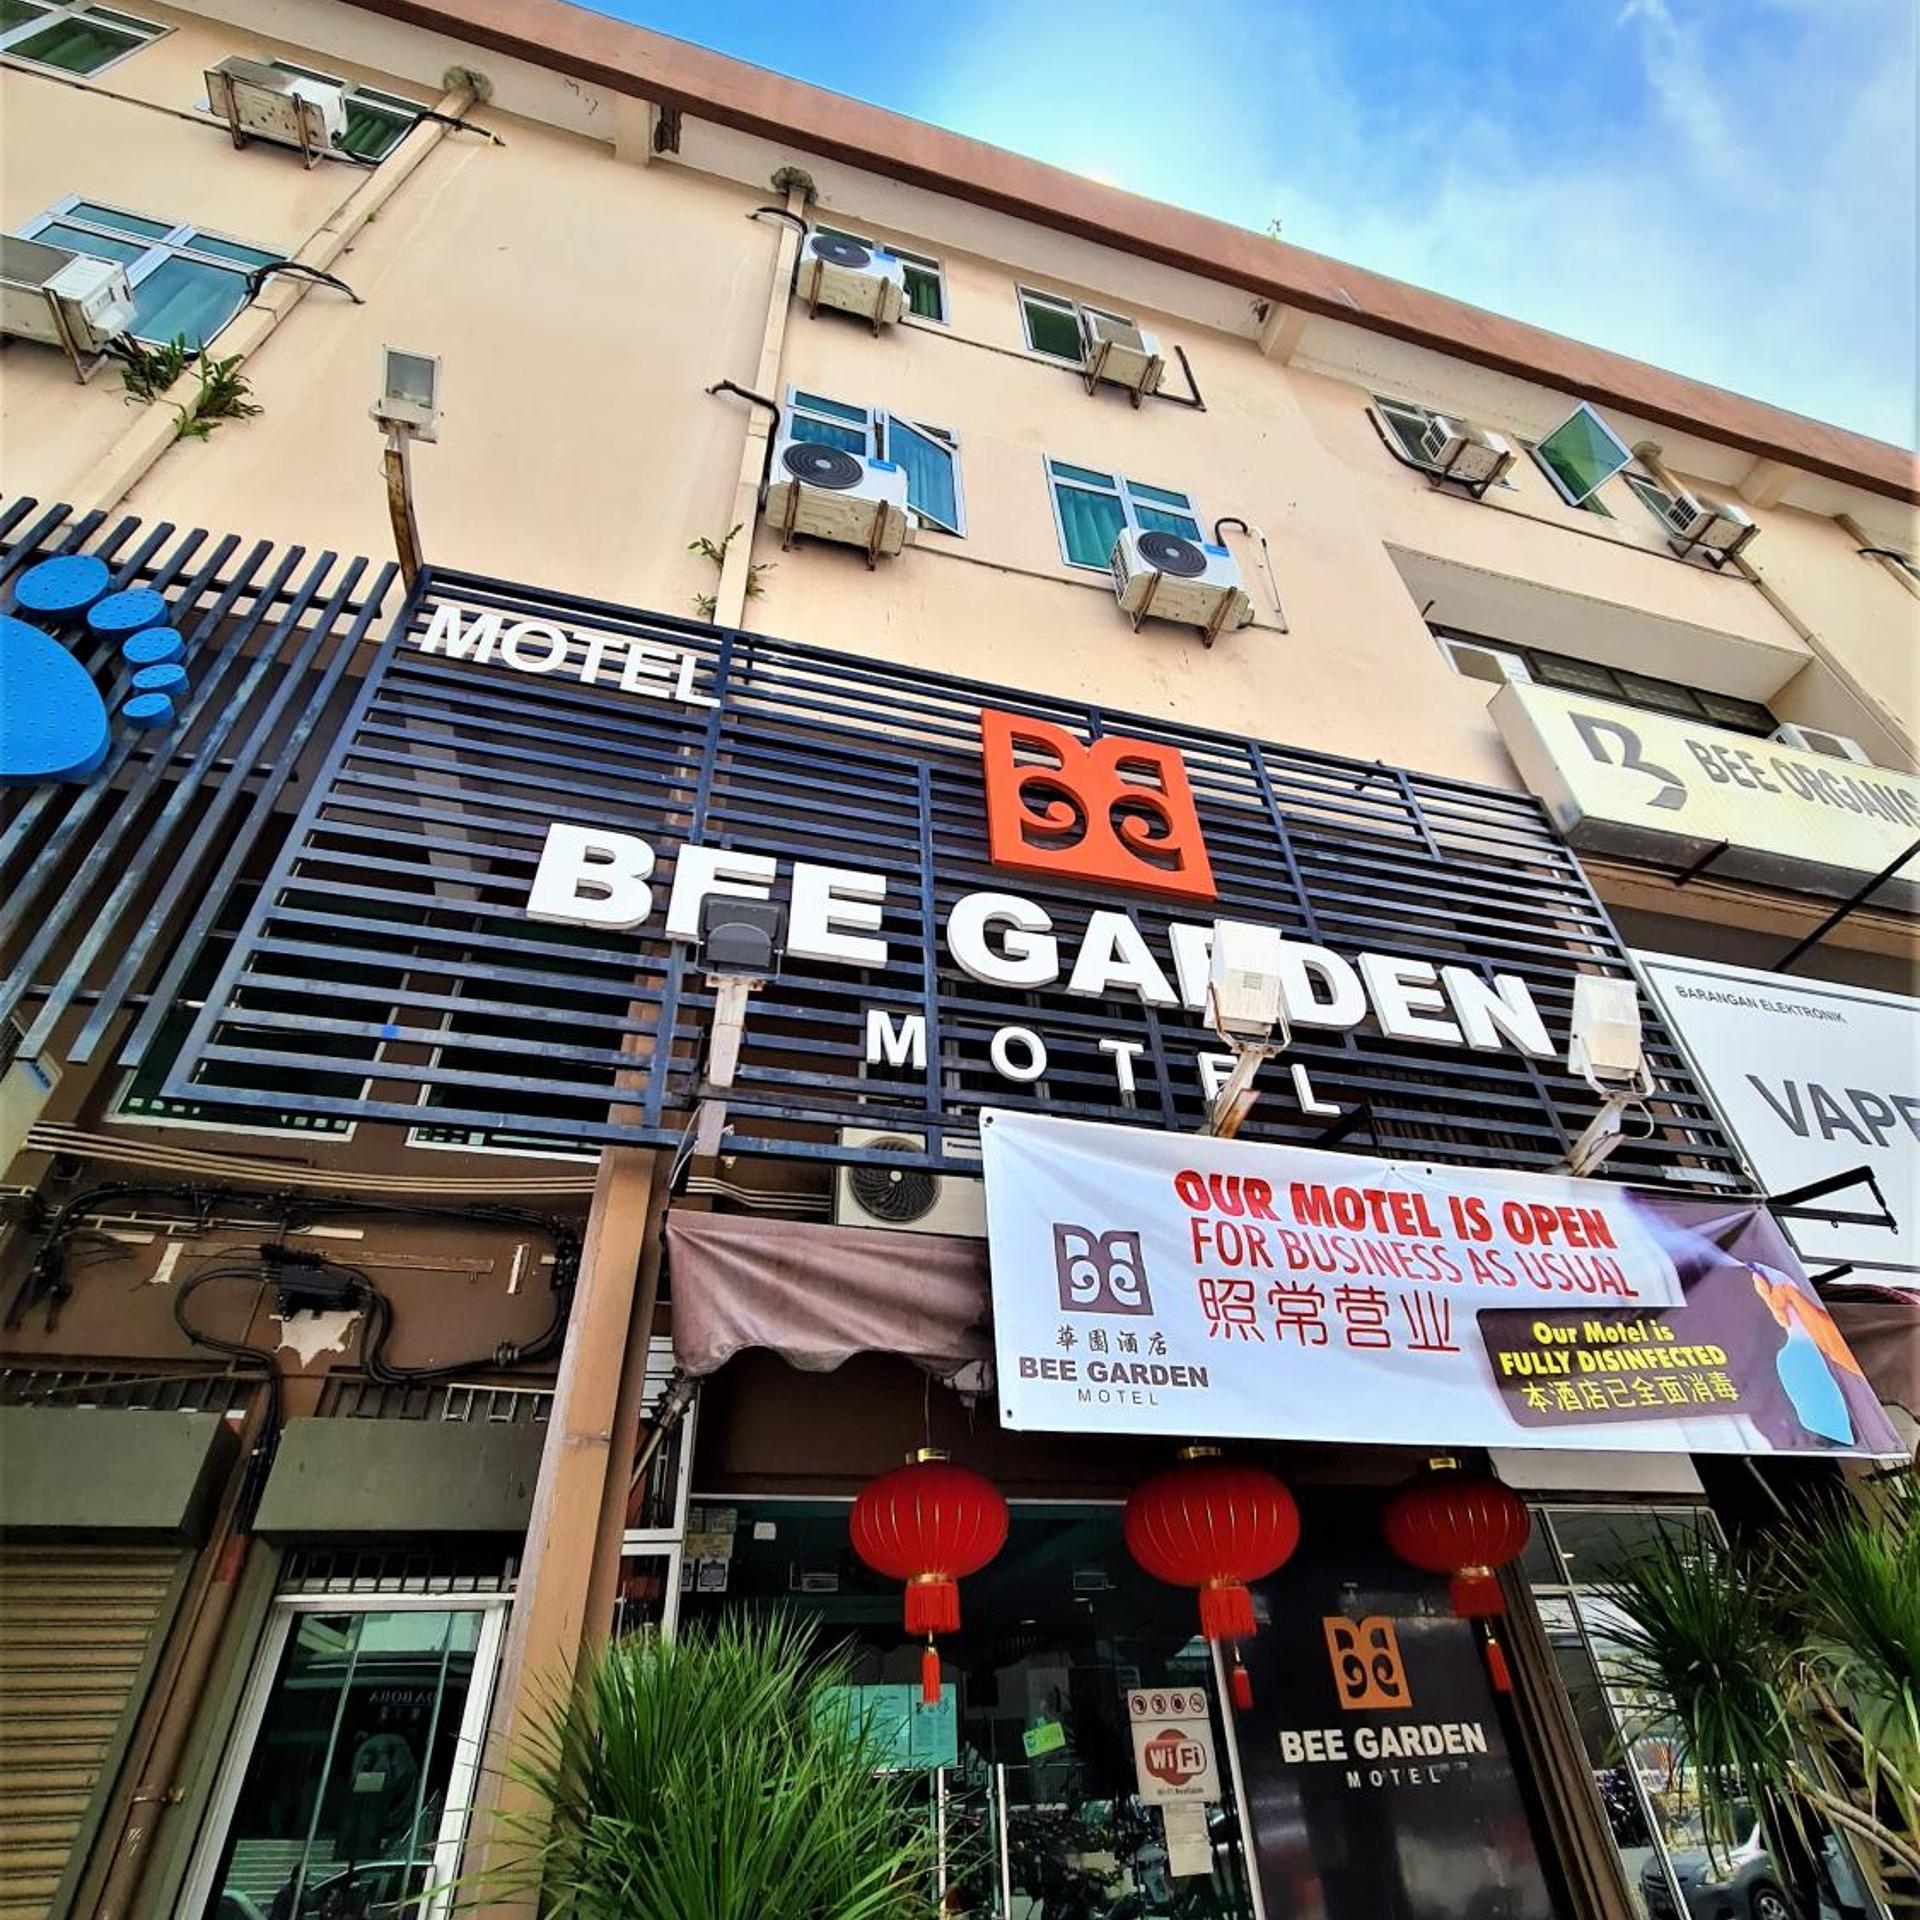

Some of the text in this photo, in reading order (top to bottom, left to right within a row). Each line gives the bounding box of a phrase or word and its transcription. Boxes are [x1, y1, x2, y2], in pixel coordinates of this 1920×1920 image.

[420, 605, 720, 707] MOTEL
[1685, 738, 1781, 794] BEE
[1675, 984, 1847, 1024] BARANGAN ELEKTRONIK
[1174, 1169, 1618, 1249] OUR MOTEL IS OPEN
[1190, 1216, 1639, 1297] FOR BUSINESS AS USUAL
[1198, 1278, 1461, 1352] 照常营业
[1532, 1318, 1675, 1345] Our Motel is
[1056, 1324, 1168, 1356] 華園酒店
[1499, 1344, 1728, 1376] FULLY DISINFECTED
[1019, 1356, 1210, 1388] BEE GARDEN
[1521, 1370, 1740, 1414] 本酒店已全面消毒
[1077, 1387, 1159, 1406] MOTEL
[1280, 1722, 1488, 1764] BEE GARDEN
[1346, 1766, 1442, 1789] MOTEL
